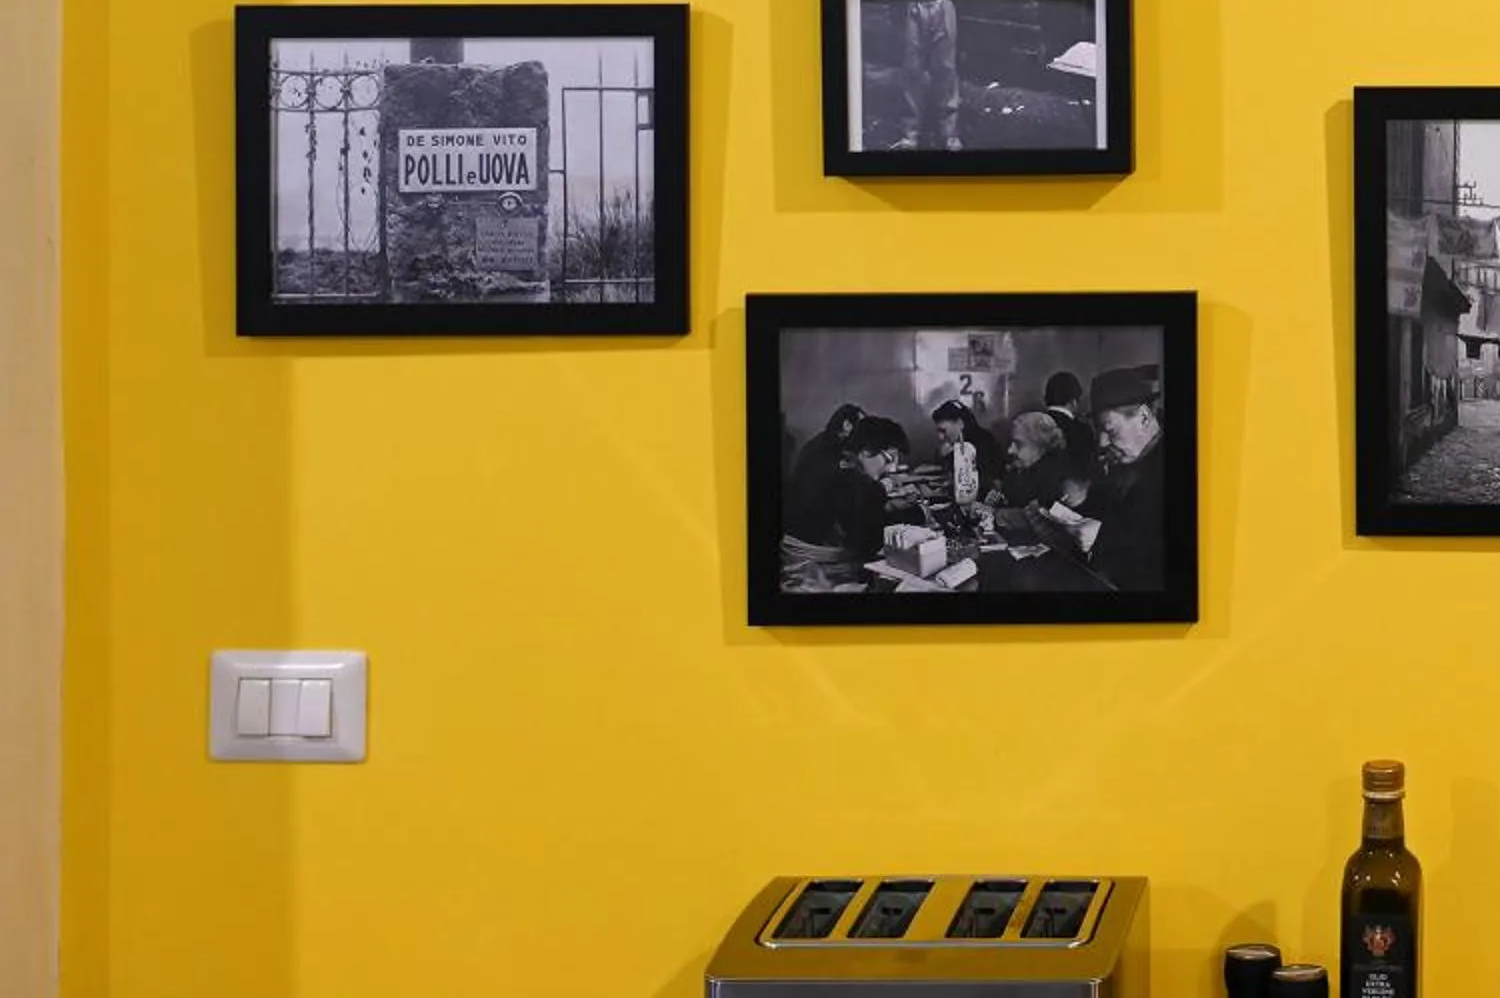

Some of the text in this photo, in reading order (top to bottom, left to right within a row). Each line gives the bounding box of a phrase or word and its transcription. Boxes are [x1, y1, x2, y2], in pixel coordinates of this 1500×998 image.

[407, 134, 527, 147] DE SIMONE VITO
[404, 152, 530, 186] POLLI e UOVA
